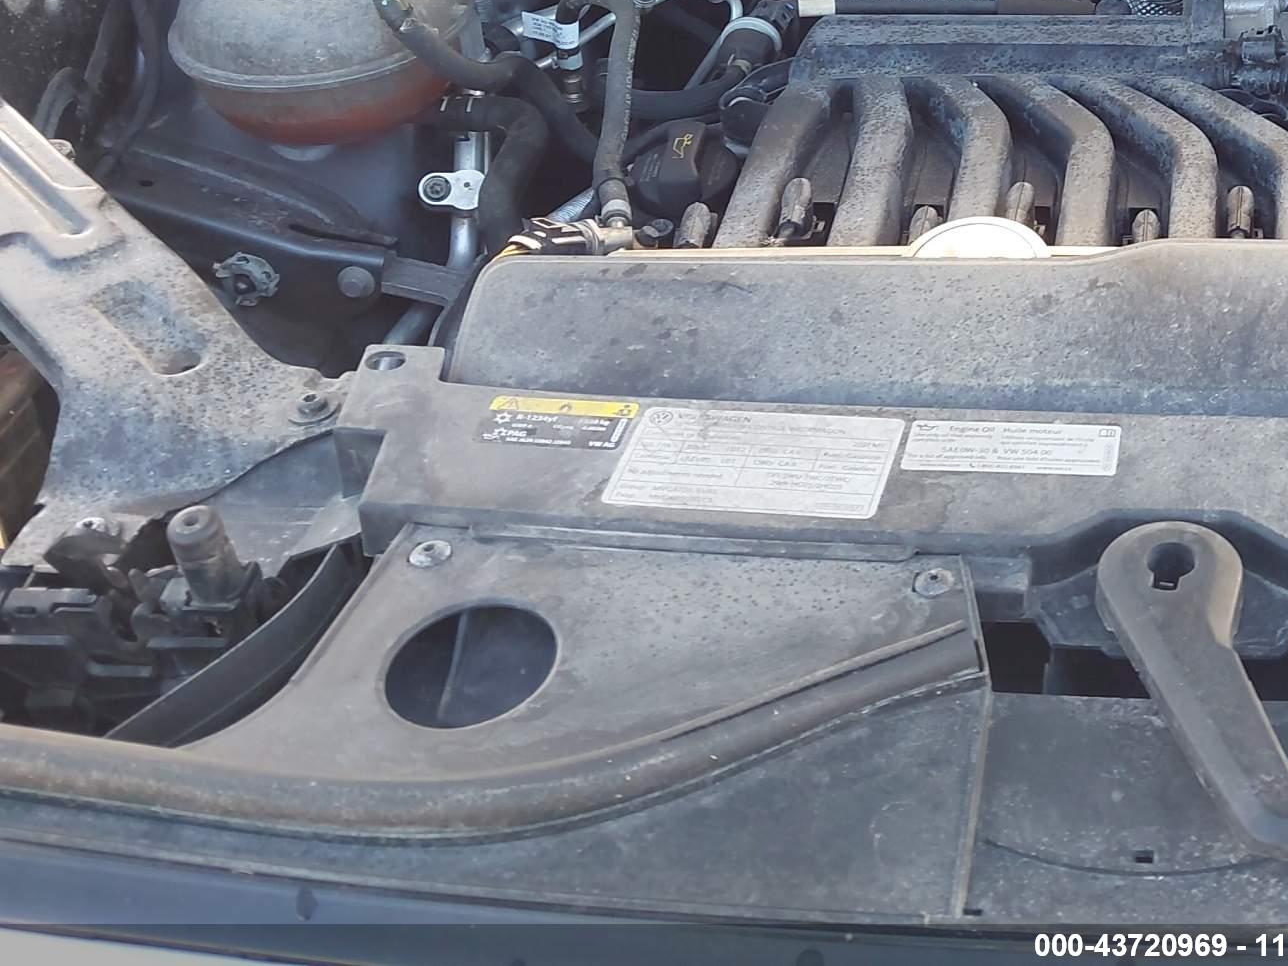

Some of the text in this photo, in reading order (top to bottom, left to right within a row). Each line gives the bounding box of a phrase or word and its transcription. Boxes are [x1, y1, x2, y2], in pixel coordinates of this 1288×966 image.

[516, 414, 559, 423] R-1234yf
[678, 412, 752, 424] VOSWAGEN
[949, 425, 981, 434] Engine
[1020, 448, 1038, 456] 504
